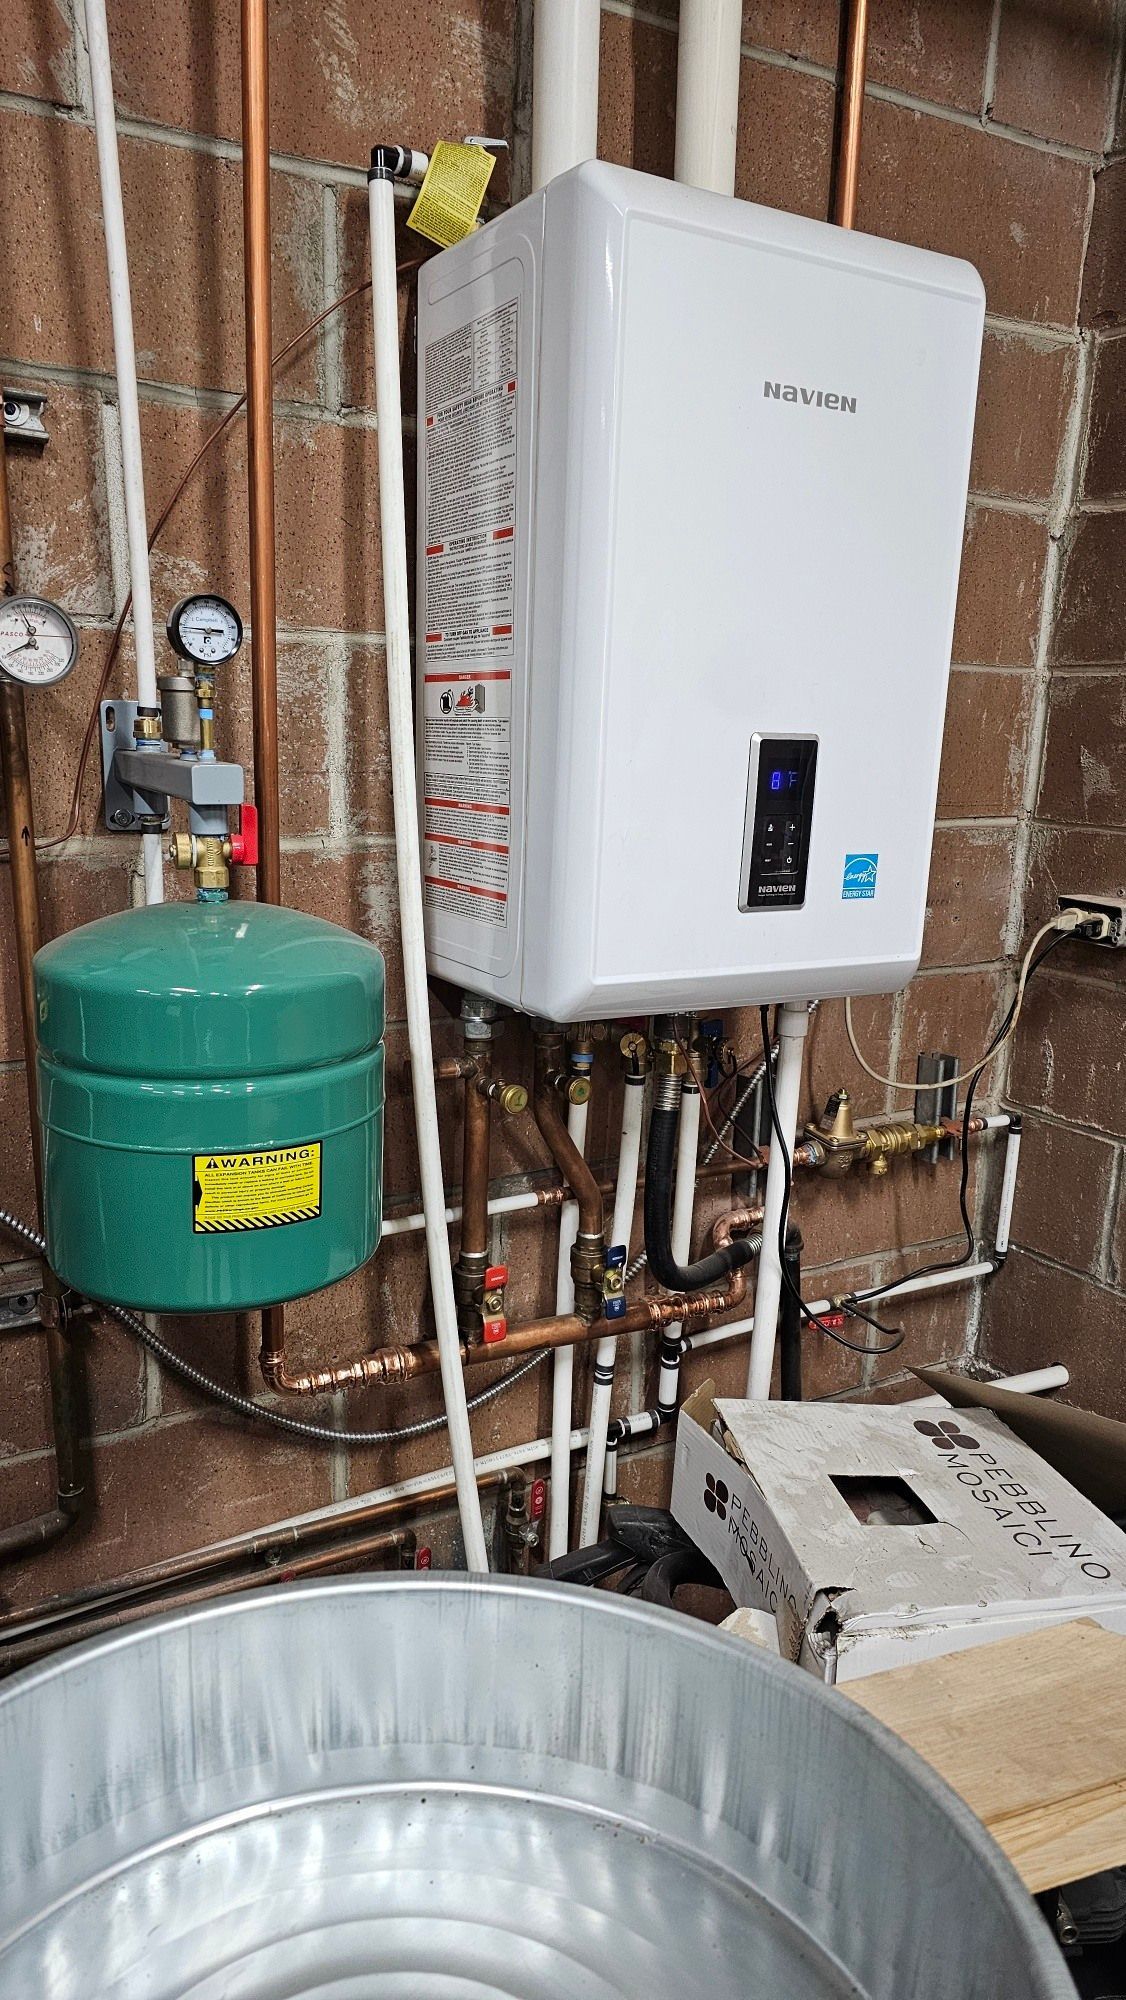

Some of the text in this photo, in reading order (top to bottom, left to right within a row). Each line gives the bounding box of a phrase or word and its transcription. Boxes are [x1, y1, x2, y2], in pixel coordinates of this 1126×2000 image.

[0, 630, 24, 638] PASCO
[843, 889, 874, 898] ENERGY STAR
[221, 1149, 315, 1168] WARNING:
[937, 1453, 1053, 1557] MOSAICI
[968, 1452, 1112, 1580] PEBBLINO
